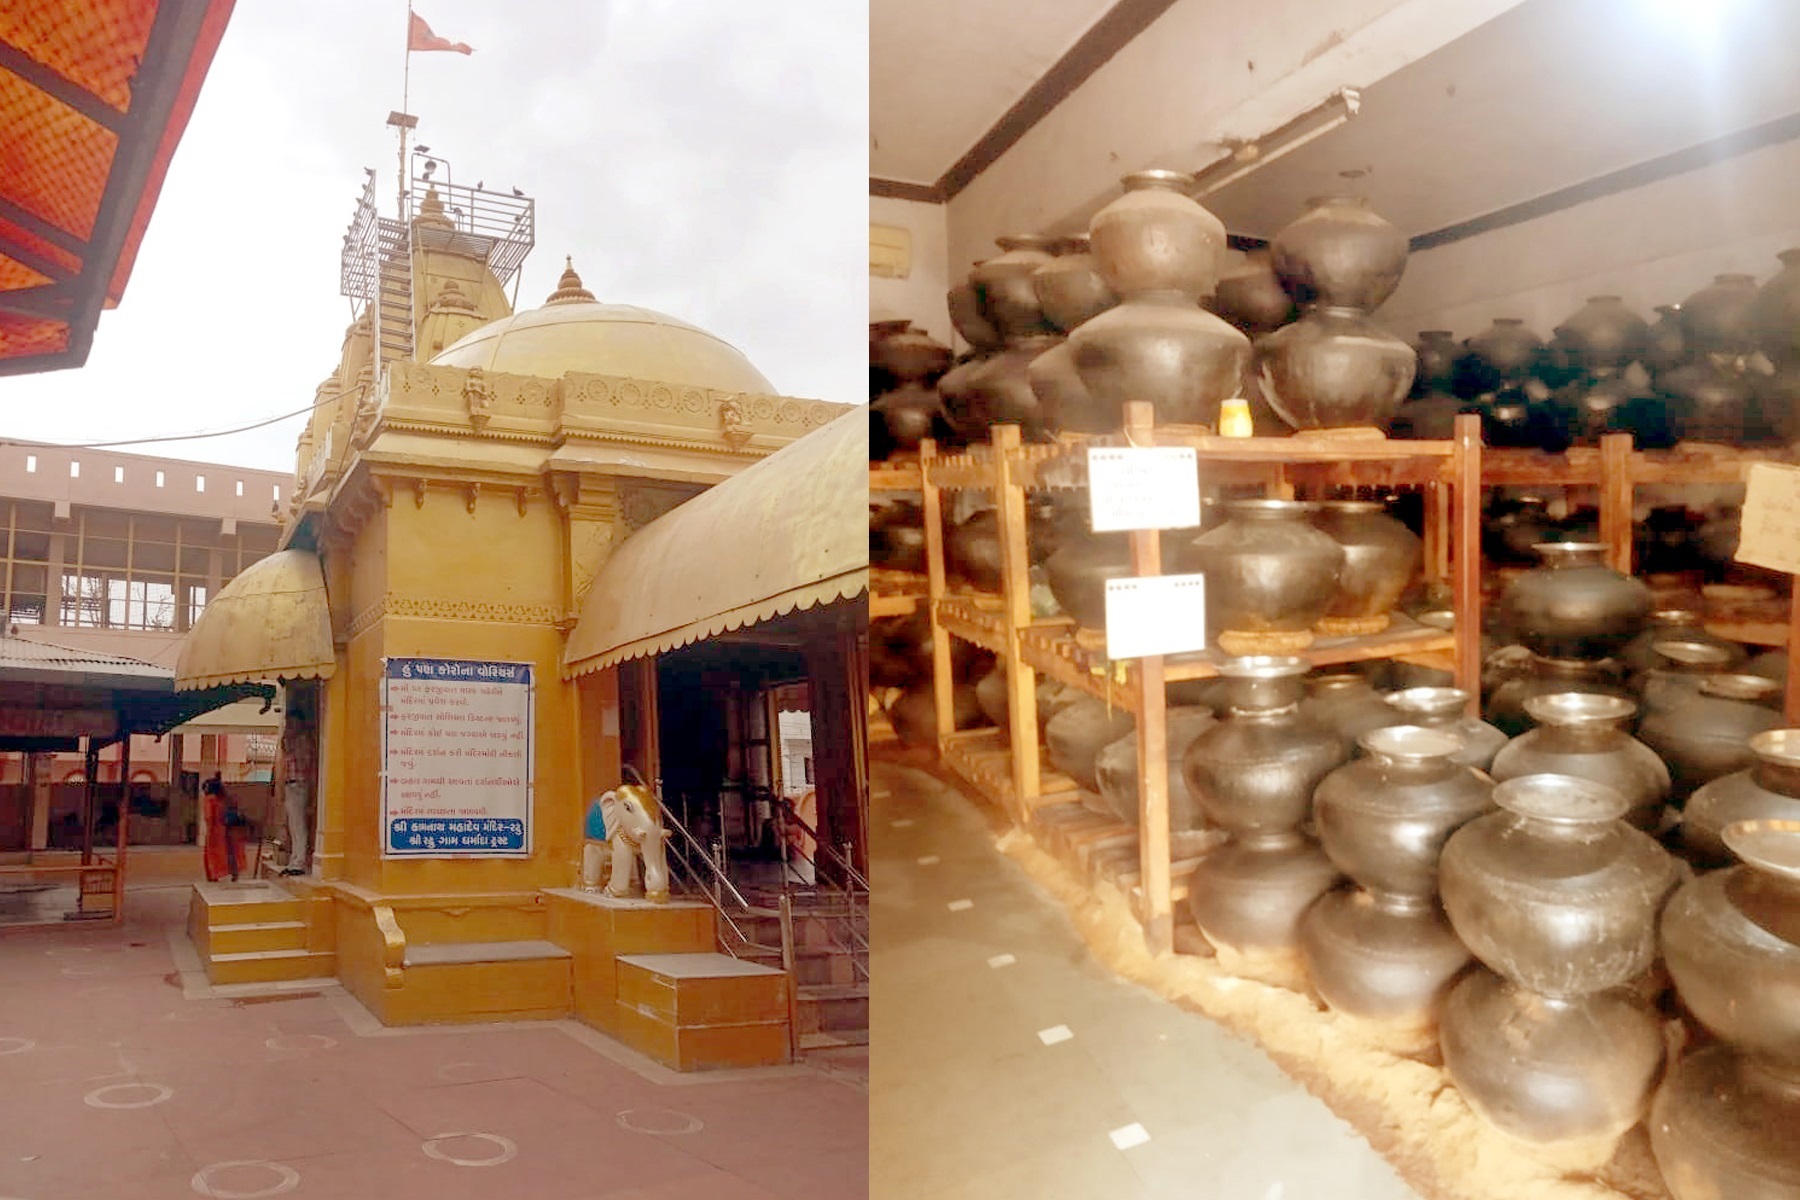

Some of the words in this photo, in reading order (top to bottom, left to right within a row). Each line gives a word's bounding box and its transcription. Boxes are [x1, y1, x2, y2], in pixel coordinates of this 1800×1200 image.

[402, 662, 411, 677] હું
[416, 664, 434, 675] પણ
[438, 664, 474, 677] કોરોના
[448, 819, 480, 833] મહાદેવ
